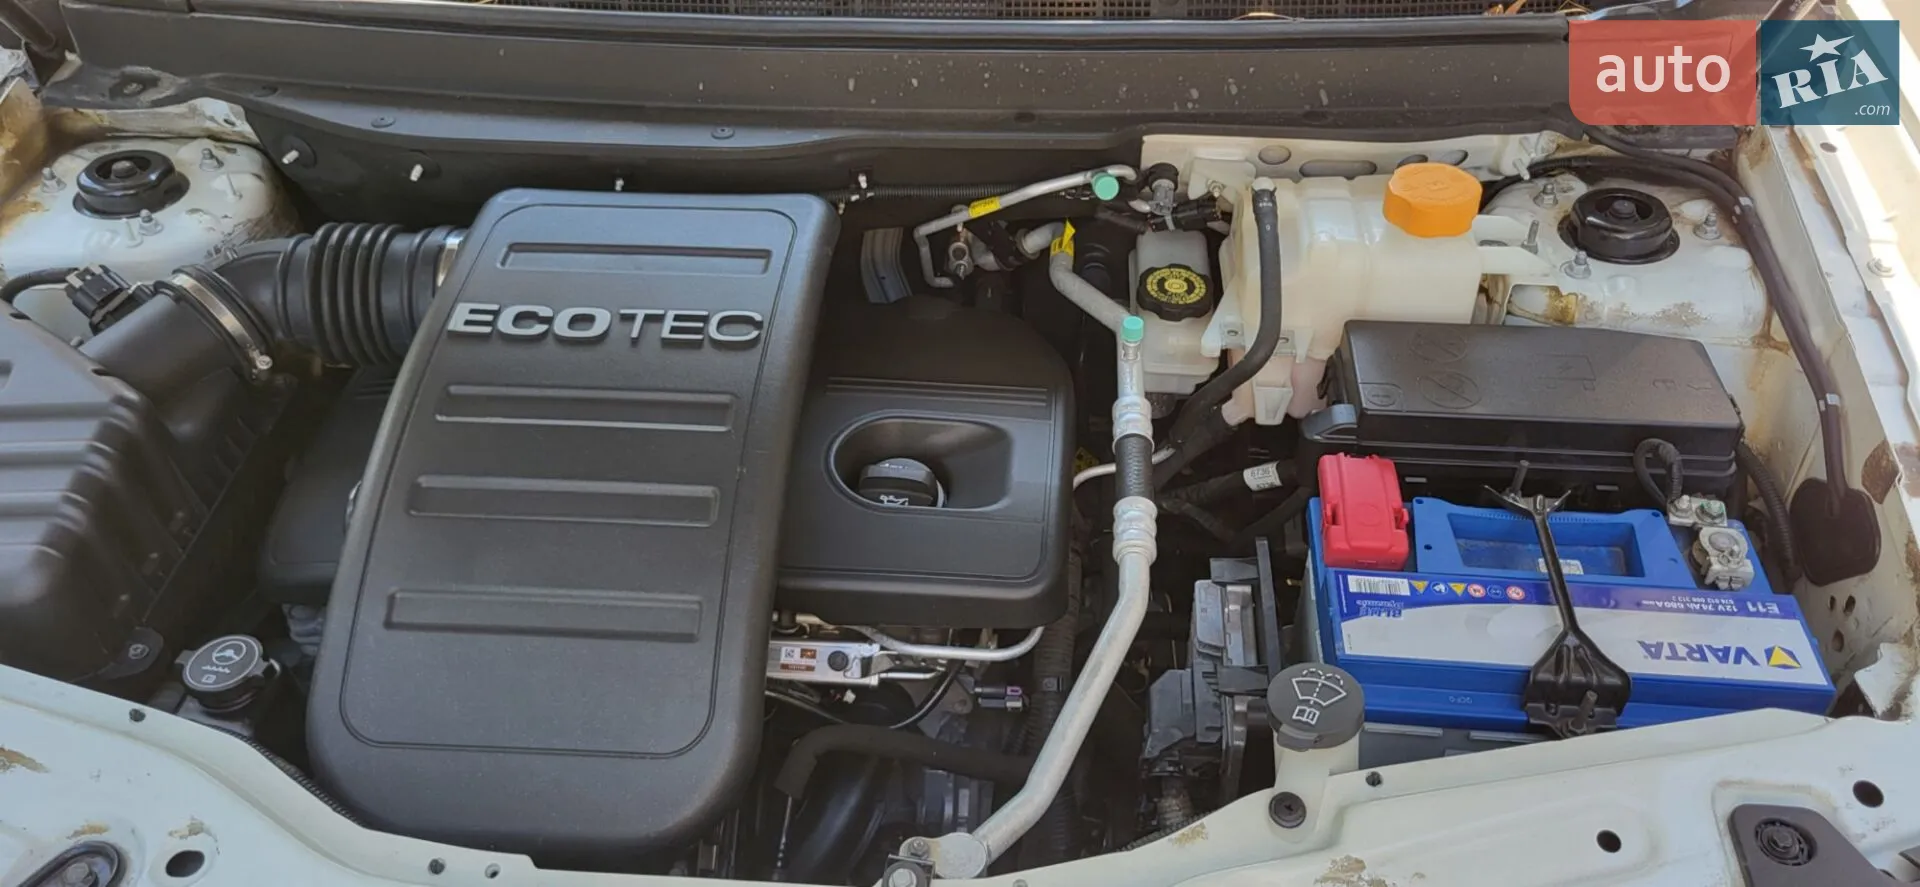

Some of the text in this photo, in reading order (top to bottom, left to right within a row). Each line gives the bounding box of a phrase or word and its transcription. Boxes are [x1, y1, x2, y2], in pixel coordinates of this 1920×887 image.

[447, 302, 764, 342] ECOTEC
[1717, 604, 1738, 612] 12V
[1746, 601, 1780, 615] E11
[1637, 640, 1761, 667] VARTA
